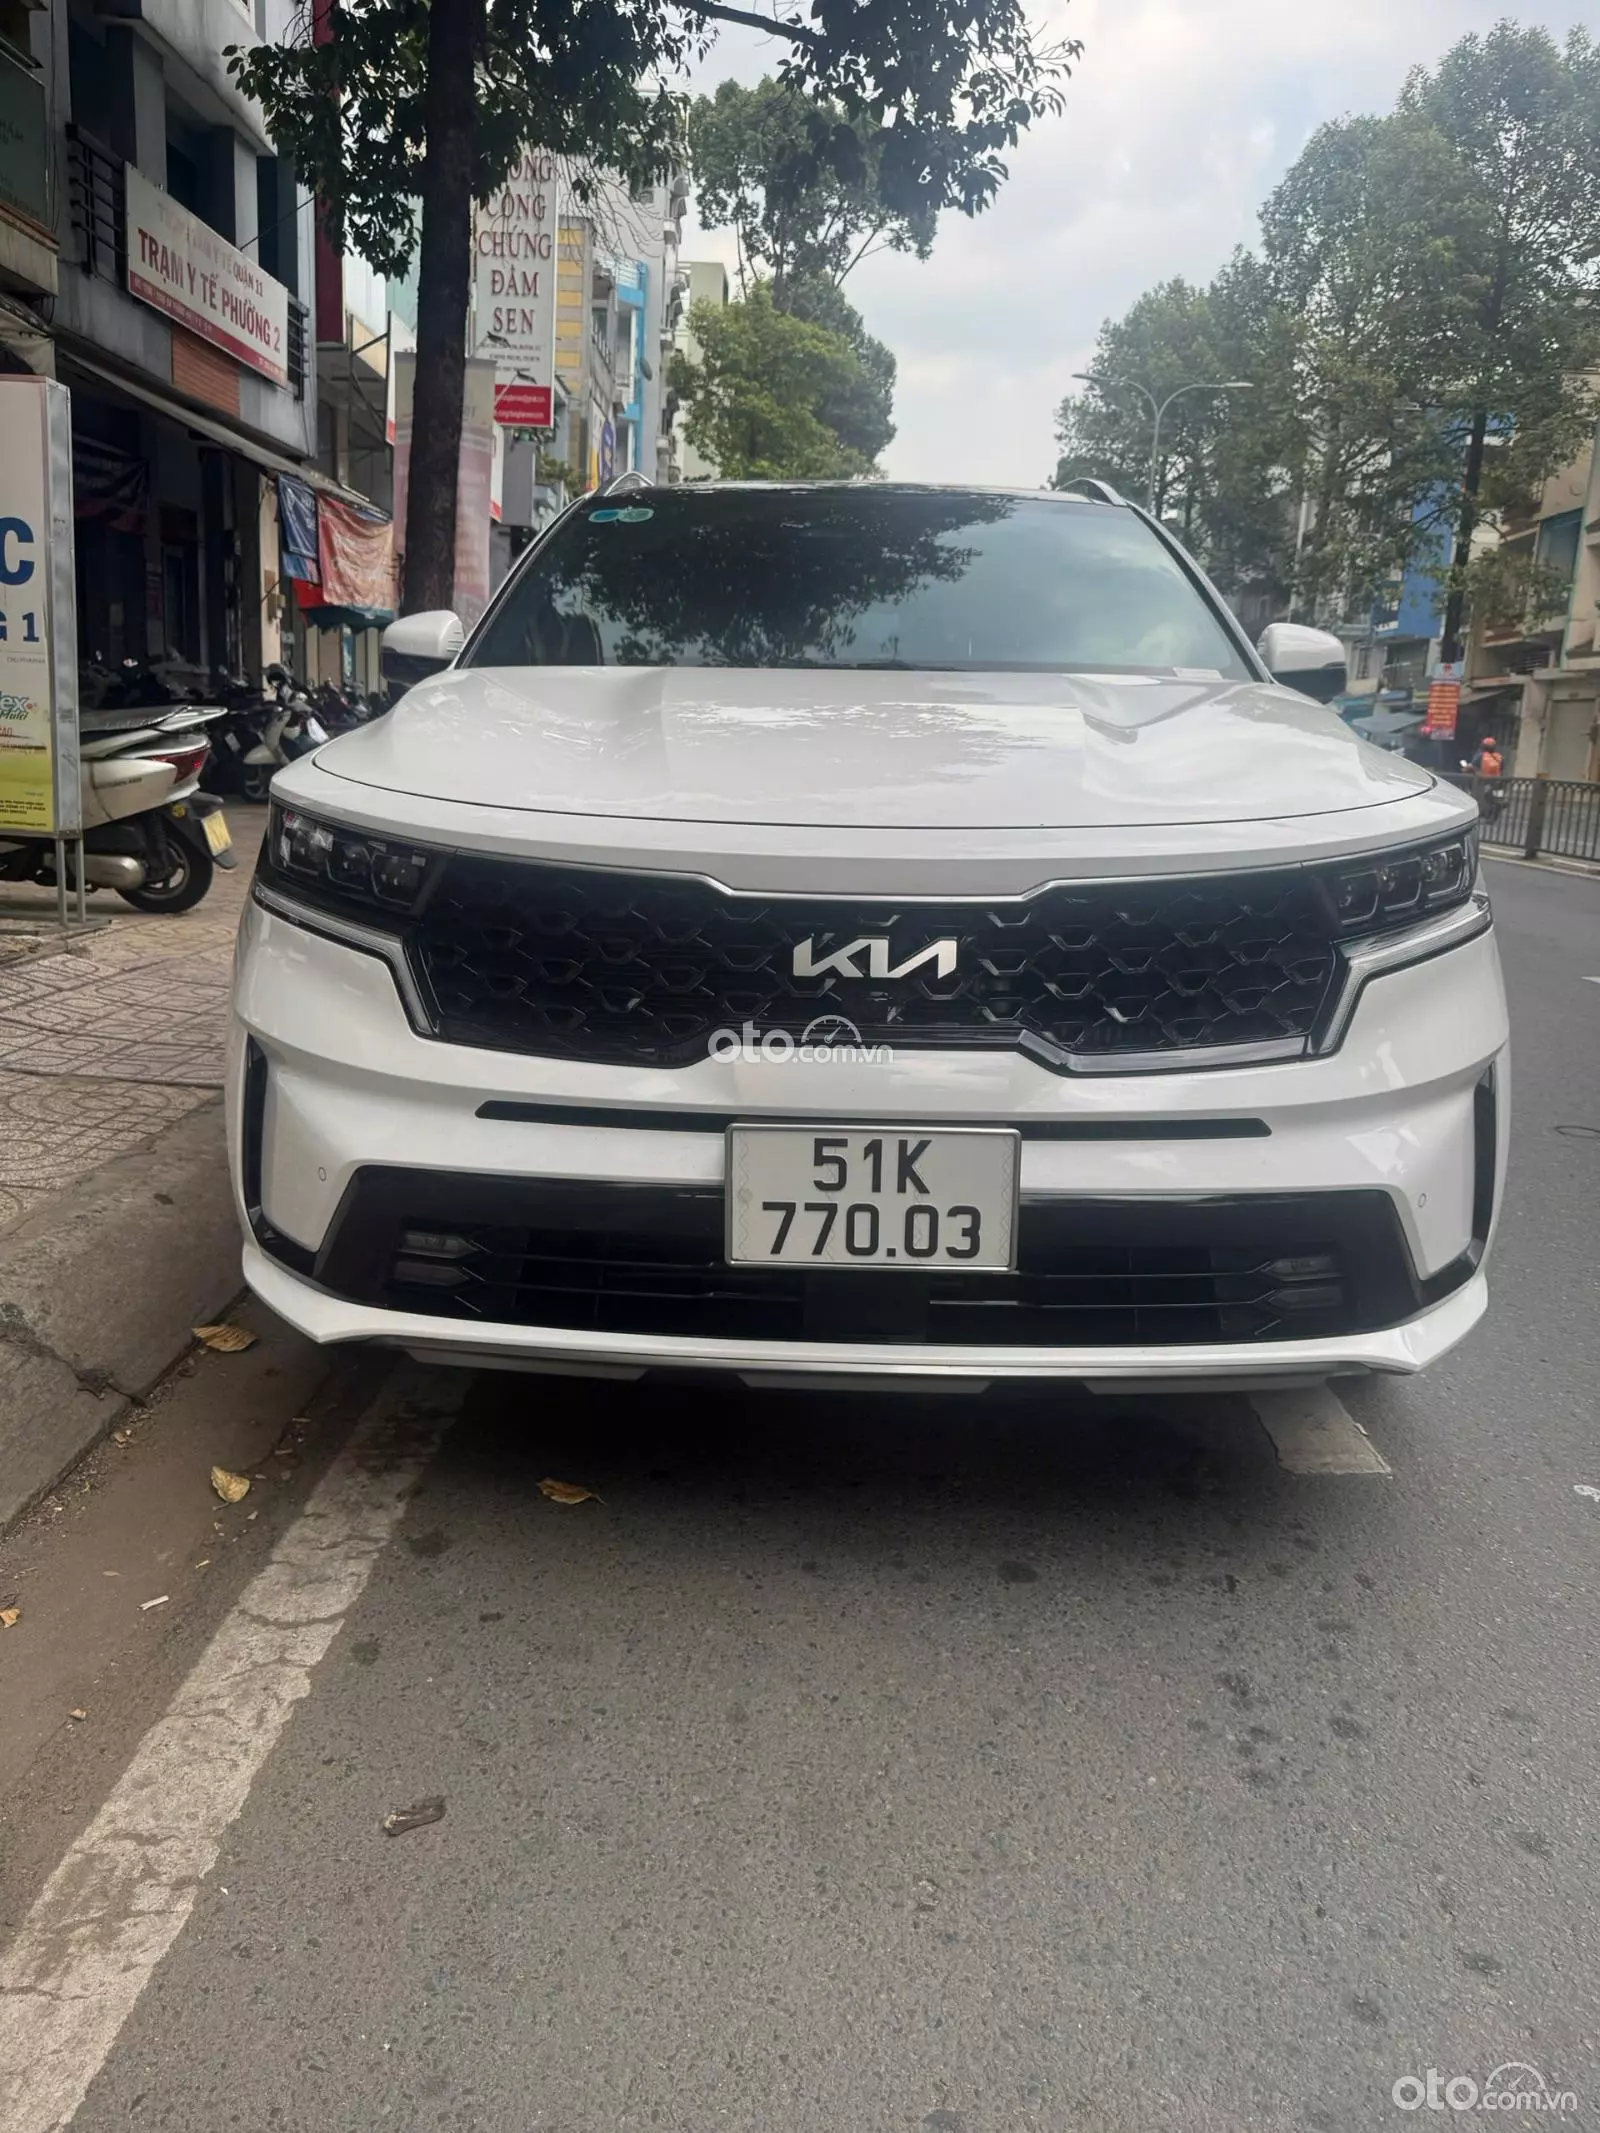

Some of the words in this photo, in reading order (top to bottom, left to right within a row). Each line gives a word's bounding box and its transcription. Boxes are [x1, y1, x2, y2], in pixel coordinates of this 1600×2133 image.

[478, 224, 552, 260] CHỨNG
[138, 227, 184, 290] TRẠM
[186, 262, 197, 295] Y
[200, 271, 220, 311] TẾ
[221, 287, 271, 348] PHƯỜNG
[273, 326, 281, 354] 2
[233, 261, 254, 289] QUẬN
[255, 276, 264, 298] 11
[493, 306, 535, 335] SEN
[793, 936, 958, 979] KIA
[813, 1138, 932, 1195] 51K
[762, 1201, 981, 1259] 770.03
